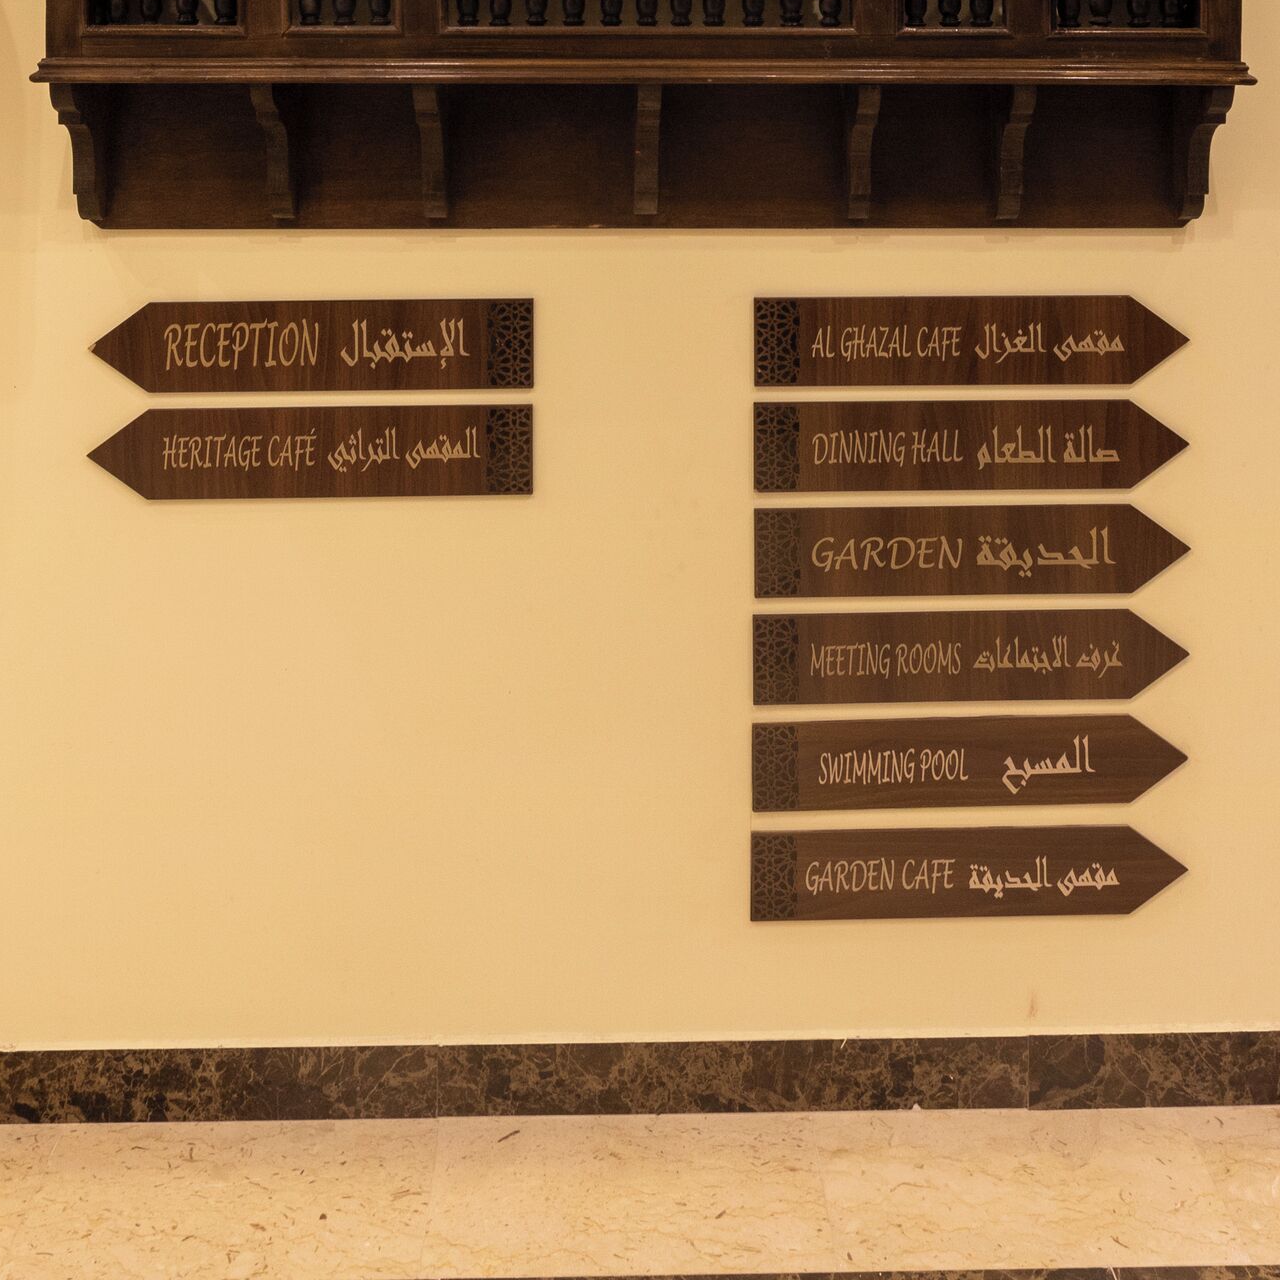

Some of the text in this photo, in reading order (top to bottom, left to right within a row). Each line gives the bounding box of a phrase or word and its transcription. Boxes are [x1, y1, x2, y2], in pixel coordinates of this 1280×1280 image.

[163, 318, 319, 371] RECEPTION
[340, 318, 469, 369] الإستقبال
[811, 324, 962, 362] AL GHAZAL CAFE
[974, 323, 1125, 364] مقهى الغزال
[162, 428, 317, 471] HERITAGE CAFÉ
[327, 427, 480, 473] المقهى التراثي
[811, 429, 963, 467] DINNING HALL
[977, 425, 1120, 470] صالة الطعام
[811, 535, 963, 573] GARDEN
[976, 526, 1116, 578] الحديقة
[810, 640, 962, 679] MEETING ROOMS
[973, 635, 1123, 678] غرف الاجتماعات
[818, 748, 969, 785] SWIMMING POOL
[1001, 735, 1095, 795] المسبح
[805, 857, 956, 896] GARDEN CAFE
[968, 856, 1120, 899] مقهى الحديقة
